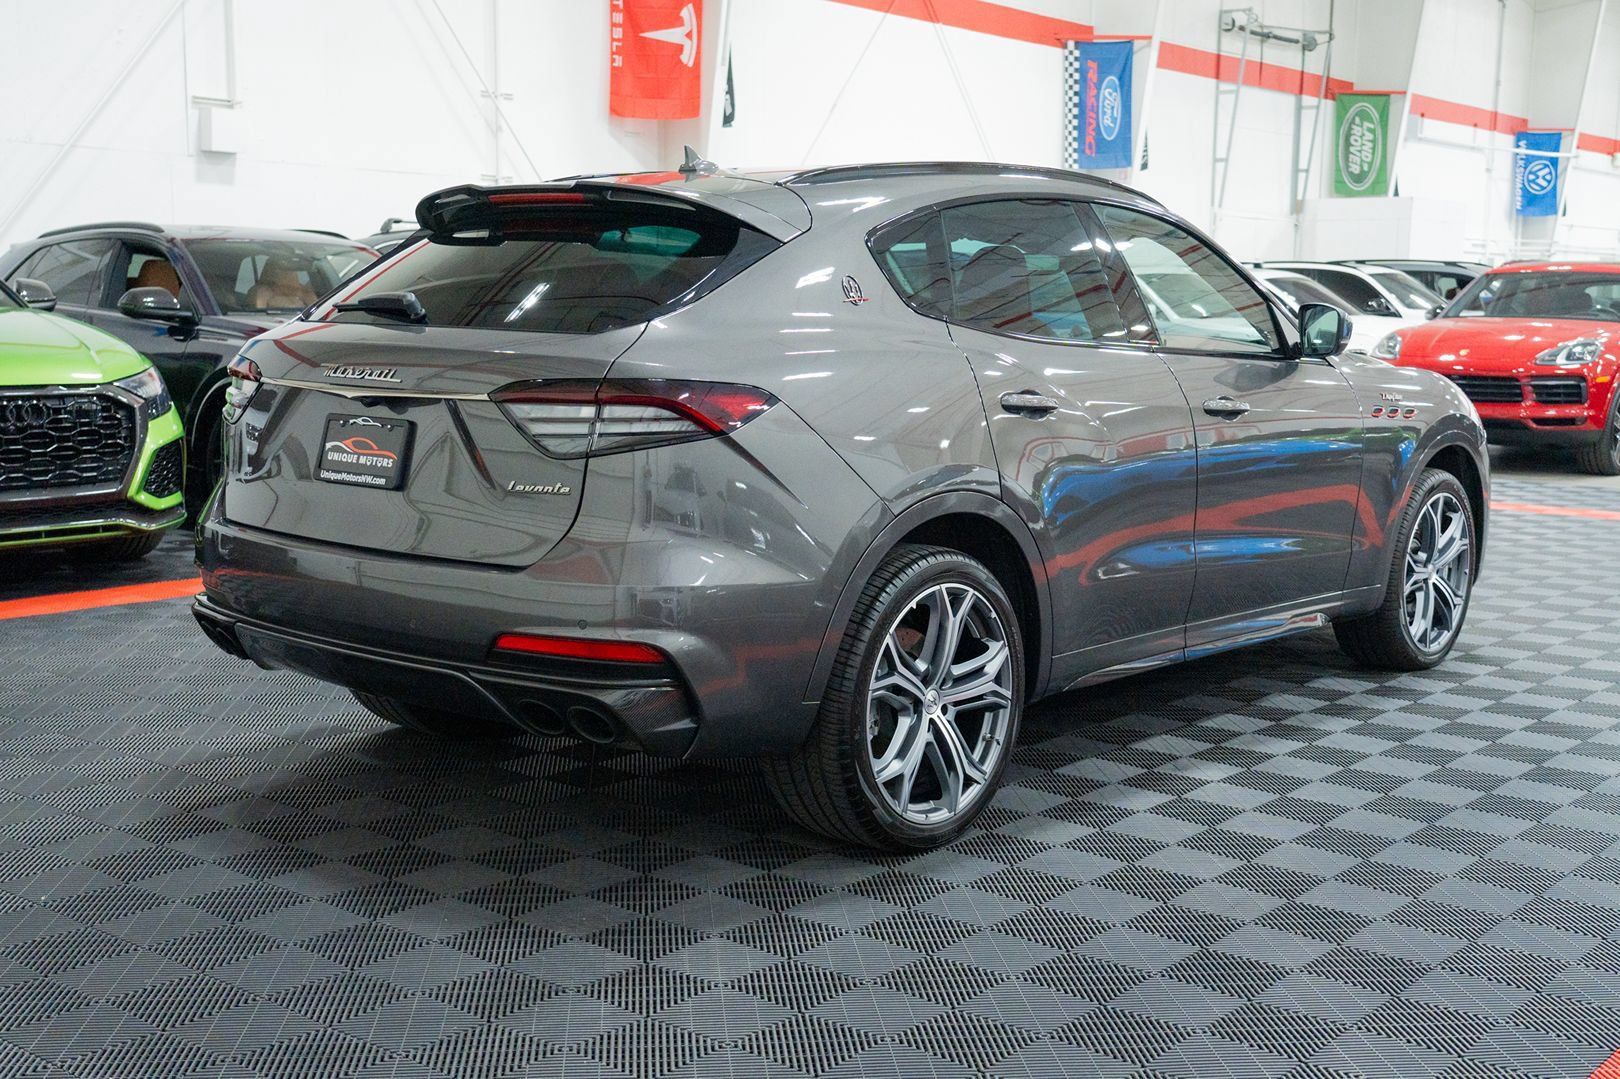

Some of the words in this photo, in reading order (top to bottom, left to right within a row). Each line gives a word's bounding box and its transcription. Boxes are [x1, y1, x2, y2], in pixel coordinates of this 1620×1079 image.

[612, 0, 624, 68] TESLA
[1084, 59, 1099, 157] RACING
[1103, 88, 1118, 128] Ford
[1348, 123, 1362, 174] ROVER
[1361, 121, 1375, 162] LAND
[320, 363, 402, 382] Maserati
[320, 469, 387, 485] UniqueMotorsNW.com
[327, 451, 357, 463] UNIQUE
[360, 455, 394, 468] MOTORS
